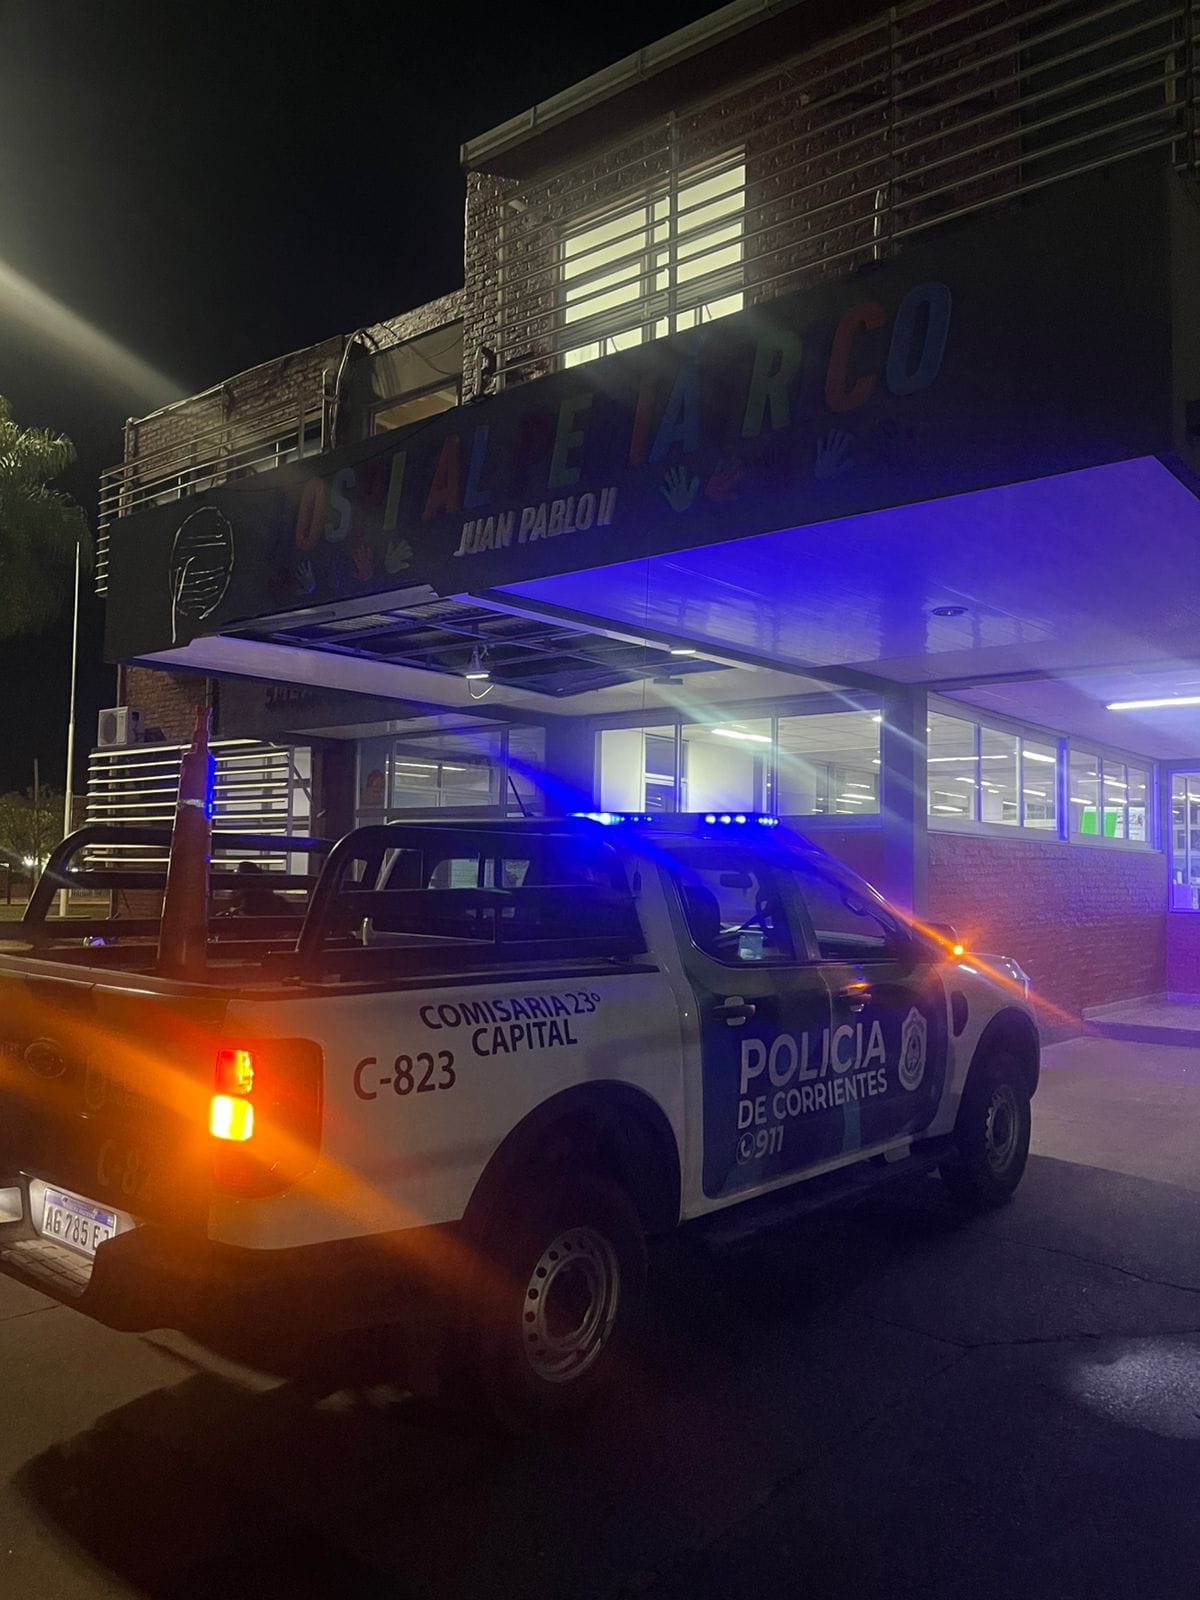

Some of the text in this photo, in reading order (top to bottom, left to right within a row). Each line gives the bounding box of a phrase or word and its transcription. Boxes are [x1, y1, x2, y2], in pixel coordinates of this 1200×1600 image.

[453, 510, 515, 557] JUAN
[518, 492, 595, 543] PABLO
[419, 994, 571, 1030] COMISARIA
[471, 1019, 578, 1057] CAPITAL
[740, 1020, 886, 1095] POLICIA
[353, 1051, 456, 1101] C-823
[737, 1068, 888, 1129] DE CORRIENTES
[754, 1126, 784, 1158] 911
[45, 1205, 61, 1234] AG
[64, 1213, 88, 1246] 785
